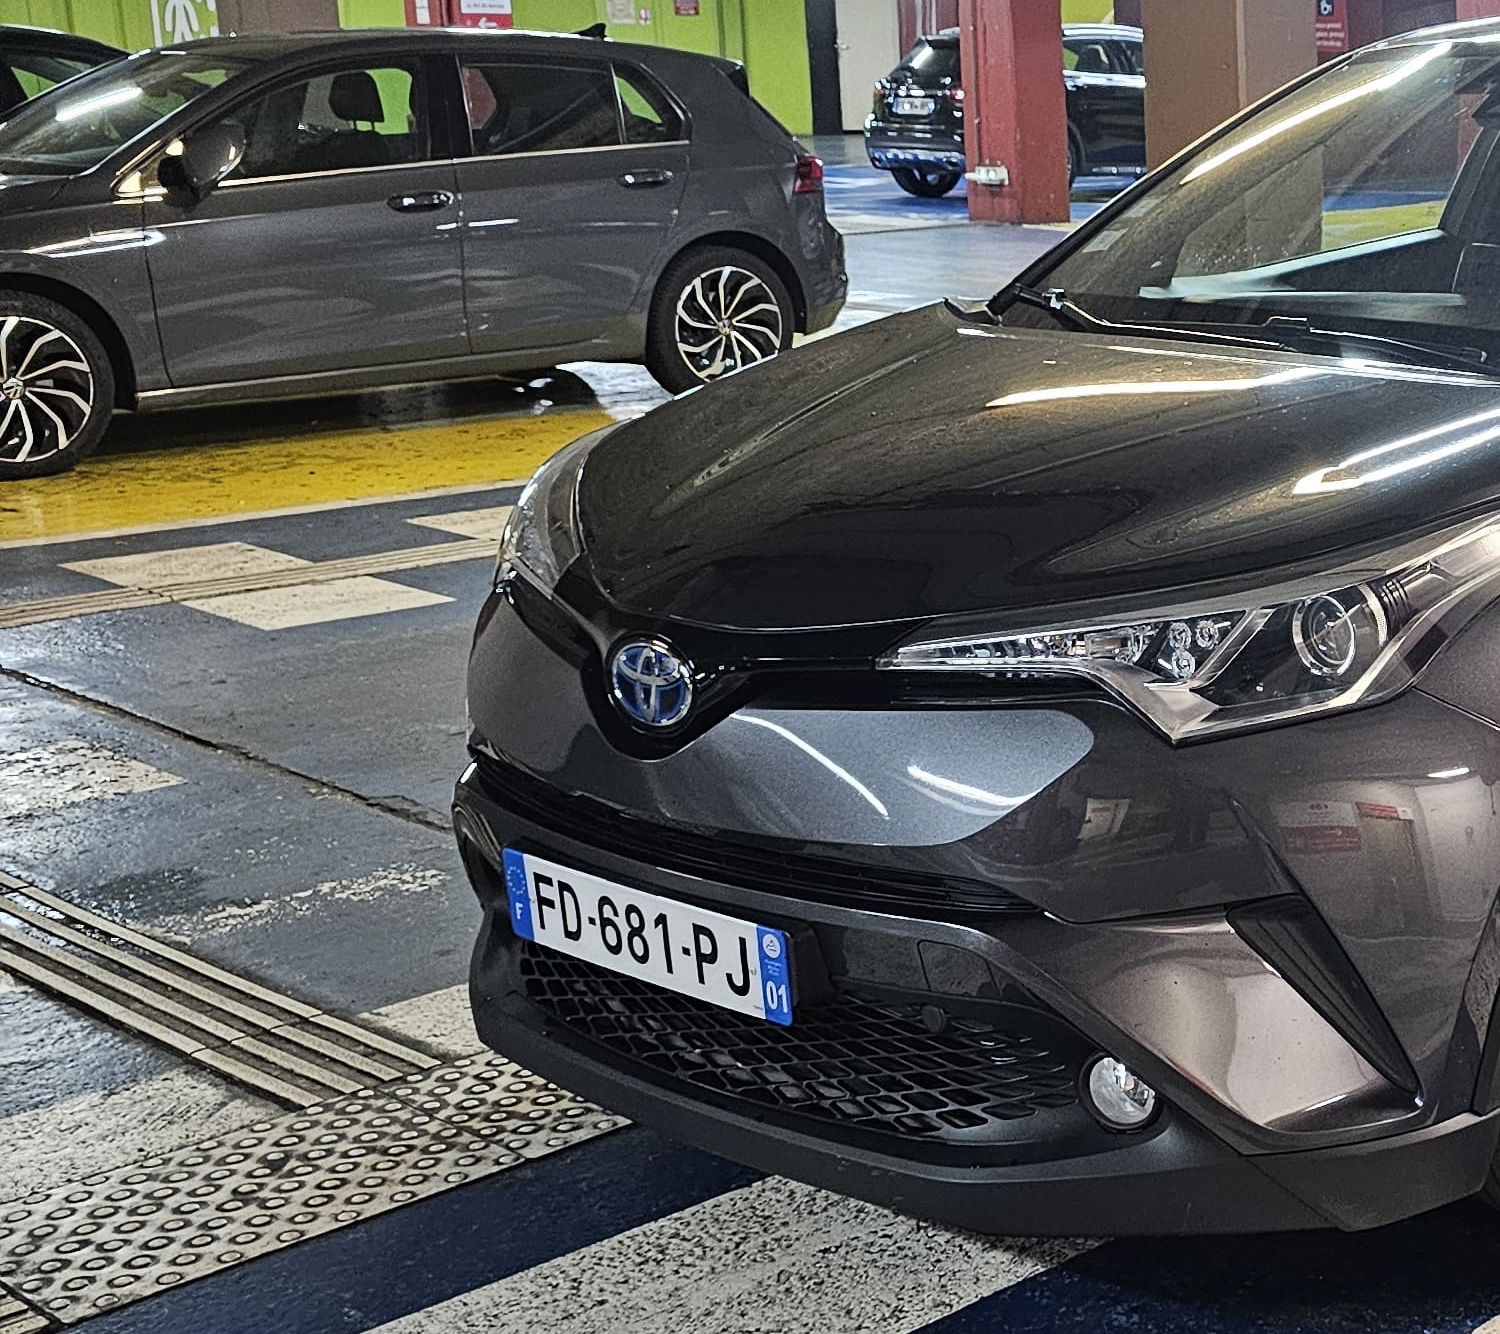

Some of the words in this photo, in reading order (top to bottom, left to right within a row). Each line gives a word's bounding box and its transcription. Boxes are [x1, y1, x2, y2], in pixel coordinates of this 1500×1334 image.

[515, 901, 524, 920] F
[533, 871, 751, 997] FD-681-PJ
[766, 980, 788, 1014] 01
